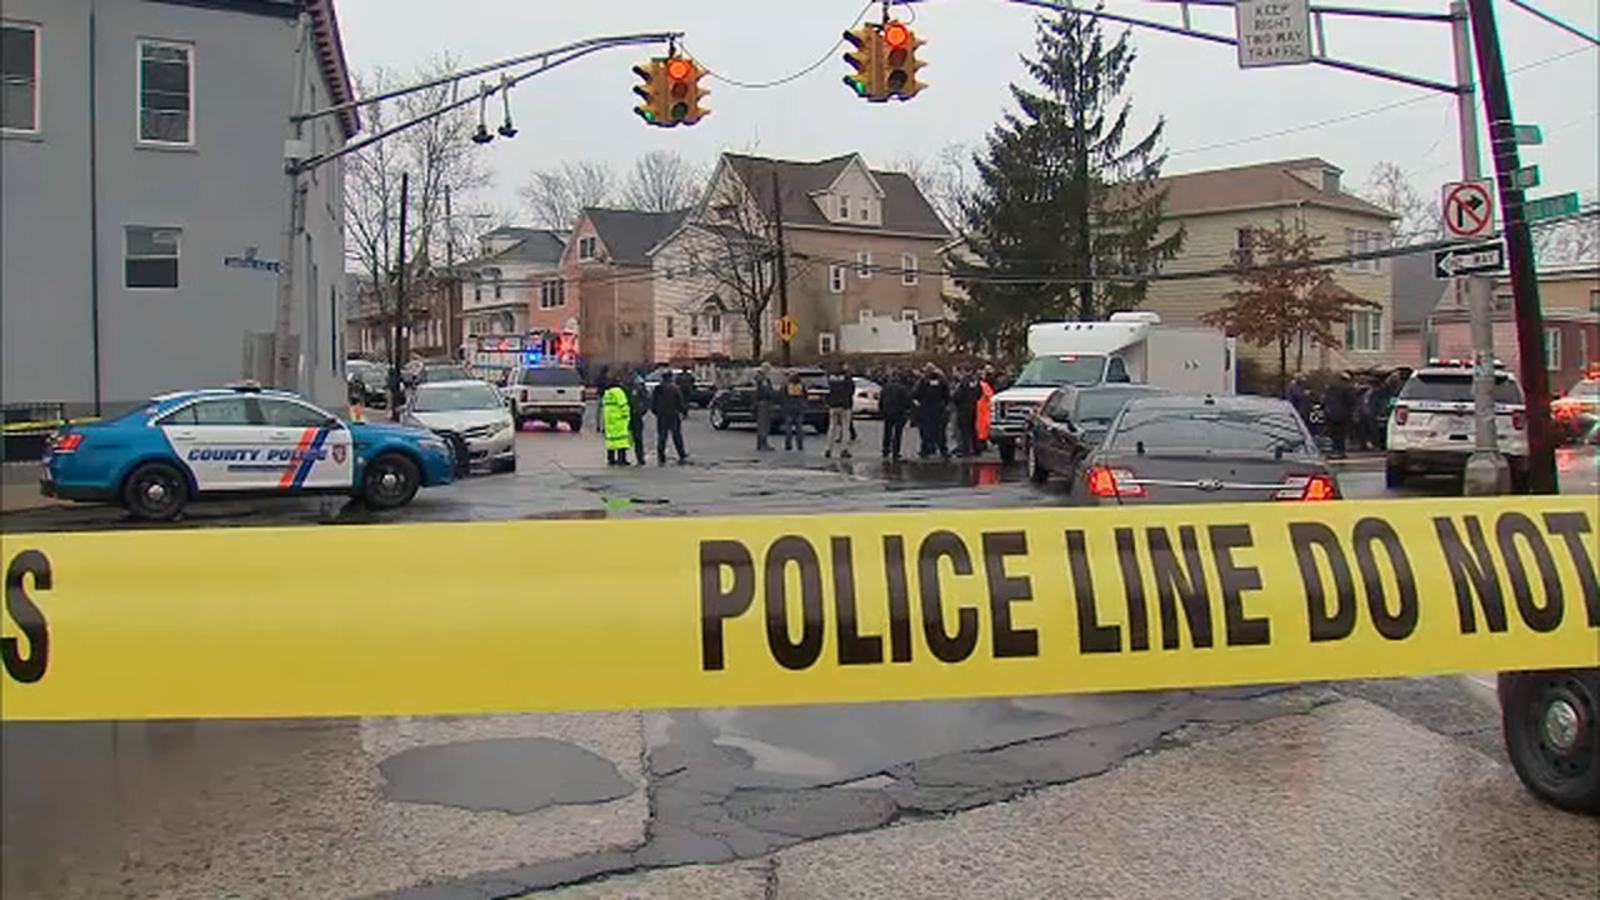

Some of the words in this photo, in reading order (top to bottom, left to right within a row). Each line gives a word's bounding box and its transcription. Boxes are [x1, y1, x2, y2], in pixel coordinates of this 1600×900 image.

[1255, 4, 1288, 16] KEEP
[1254, 17, 1291, 30] RIGHT
[1245, 33, 1273, 45] TWO
[1277, 29, 1303, 42] WAY
[1249, 44, 1305, 60] TRAFFIC
[187, 448, 261, 462] COUNTY
[266, 448, 328, 462] POLICE
[700, 529, 1039, 671] POLICE
[1065, 523, 1271, 655] LINE
[1288, 516, 1420, 643] DO
[1431, 511, 1600, 635] NOT
